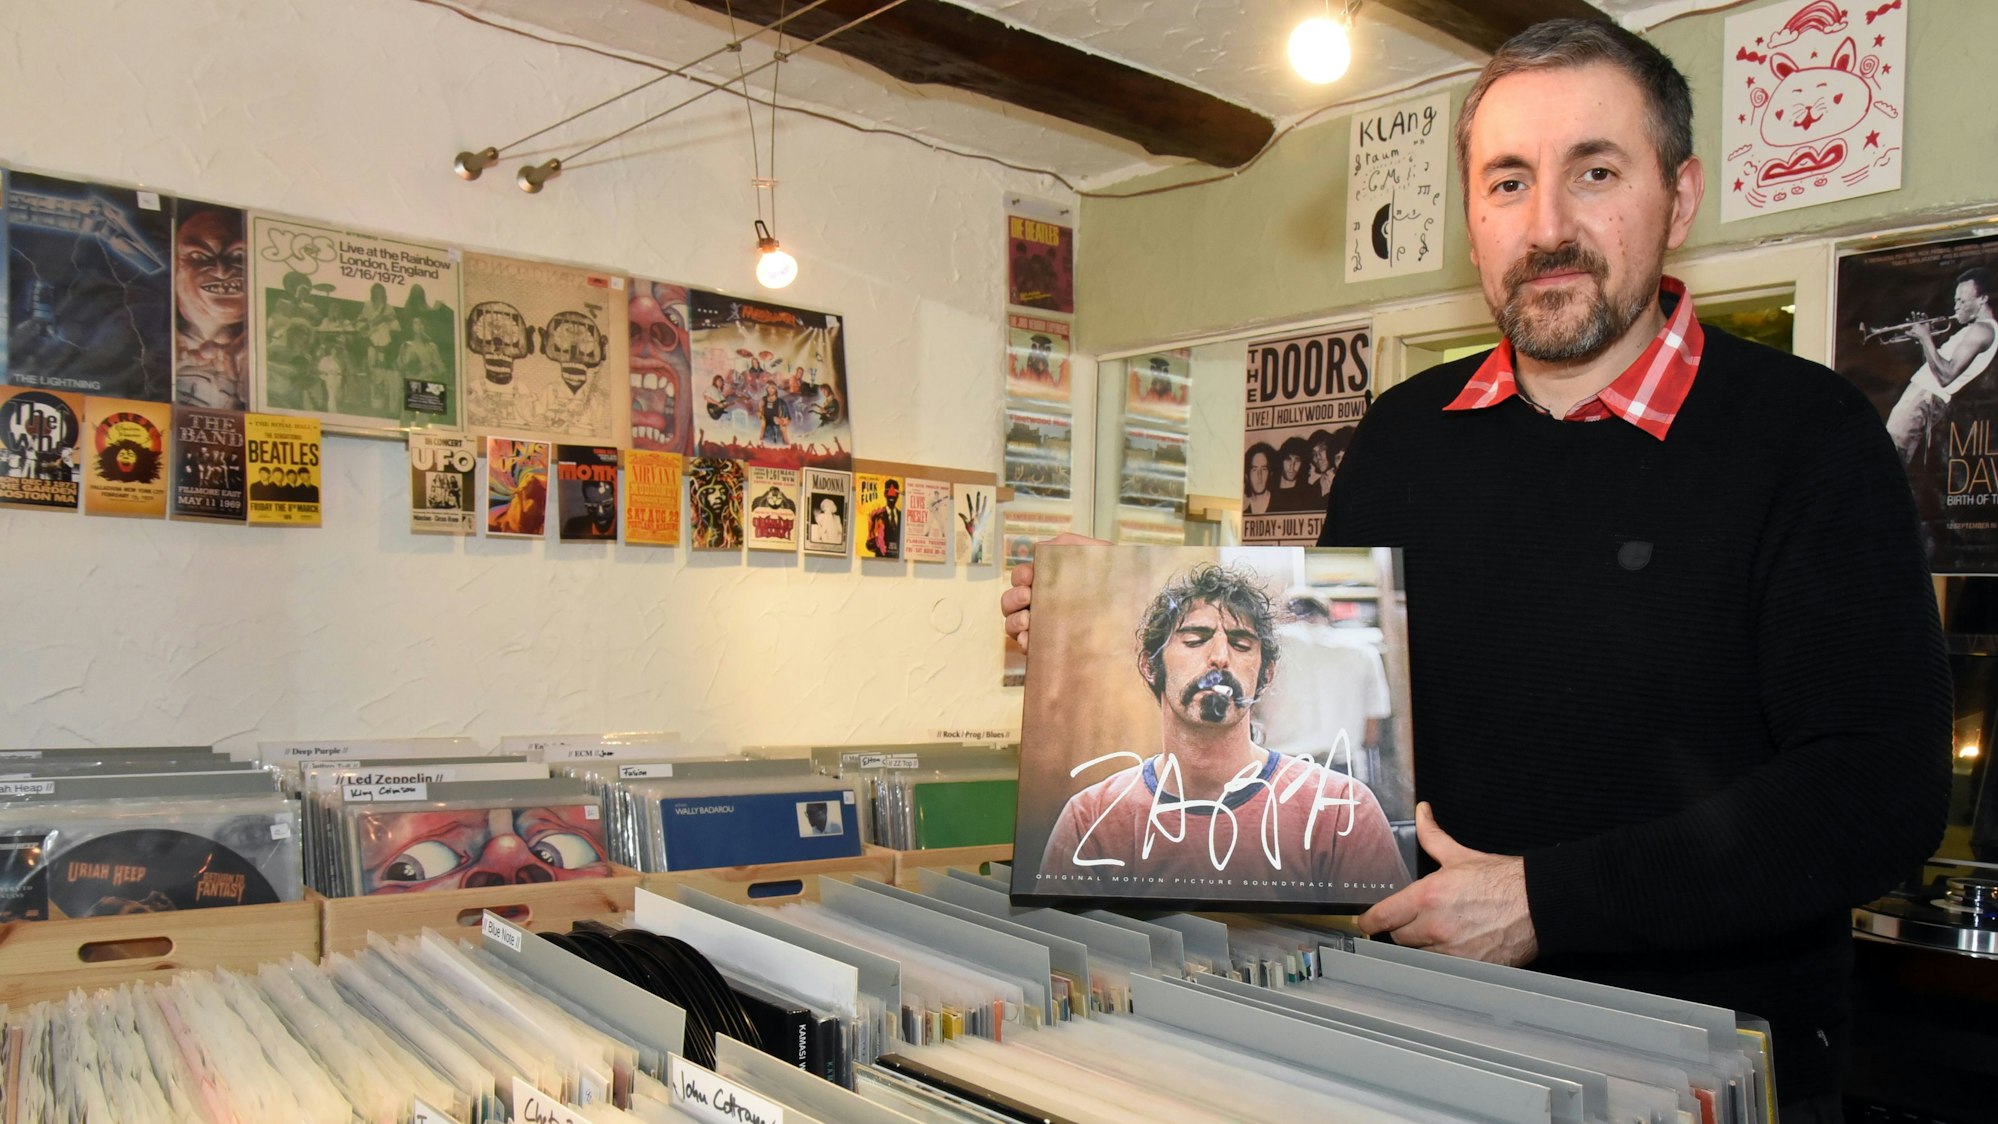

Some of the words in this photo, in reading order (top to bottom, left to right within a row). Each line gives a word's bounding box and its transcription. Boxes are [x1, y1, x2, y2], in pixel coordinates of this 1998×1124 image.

[1025, 219, 1060, 247] BEATLES
[339, 241, 365, 255] Live
[366, 247, 378, 258] at
[380, 248, 399, 261] the
[400, 251, 451, 270] Rainbow
[340, 266, 406, 286] 12/16/1972
[391, 261, 439, 280] England
[1247, 349, 1259, 402] THE
[1260, 333, 1370, 403] DOORS
[14, 373, 39, 384] THE
[40, 376, 101, 390] LIGHTNING
[189, 414, 236, 433] THE
[1246, 410, 1271, 428] LIVE!
[1276, 404, 1334, 425] HOLLYWOOD
[179, 427, 244, 447] BAND
[434, 438, 463, 448] CONCERT
[1948, 419, 1998, 457] MIL
[248, 439, 320, 467] BEATLES
[412, 447, 476, 473] UFO
[632, 464, 677, 485] NIRVANA
[812, 474, 844, 492] MADONNA
[0, 483, 19, 491] HE
[22, 485, 77, 495] GARDEN
[178, 486, 220, 496] FILLMORE
[221, 489, 242, 498] EAST
[861, 480, 878, 493] PINK
[54, 494, 76, 503] MA
[178, 496, 203, 506] MAY
[206, 498, 216, 507] 11
[250, 502, 272, 512] FRIDAY
[275, 503, 286, 512] THE
[861, 492, 878, 505] FLOYD
[910, 494, 926, 509] ELVIS
[1946, 494, 1975, 506] BIRTH
[1976, 493, 1989, 505] OF
[626, 507, 646, 522] SAT
[648, 509, 666, 523] AUG
[907, 509, 928, 524] PRESLEY
[943, 730, 960, 738] Rock
[965, 730, 982, 740] Prog
[985, 730, 1004, 738] Blues
[292, 747, 313, 756] Deep
[314, 747, 341, 756] Purple
[348, 774, 372, 785] Led
[14, 783, 43, 794] Heap
[1070, 728, 1361, 871] ZAPPA
[675, 807, 700, 815] WALLY
[700, 805, 735, 815] BADAROU
[113, 864, 147, 887] HEEP
[1035, 873, 1101, 882] ORIGINAL
[1243, 879, 1333, 888] SOUNDTRACK
[195, 880, 246, 903] FANTASY
[488, 921, 501, 938] Blue
[502, 927, 515, 946] Note
[798, 1024, 807, 1060] KAMASI
